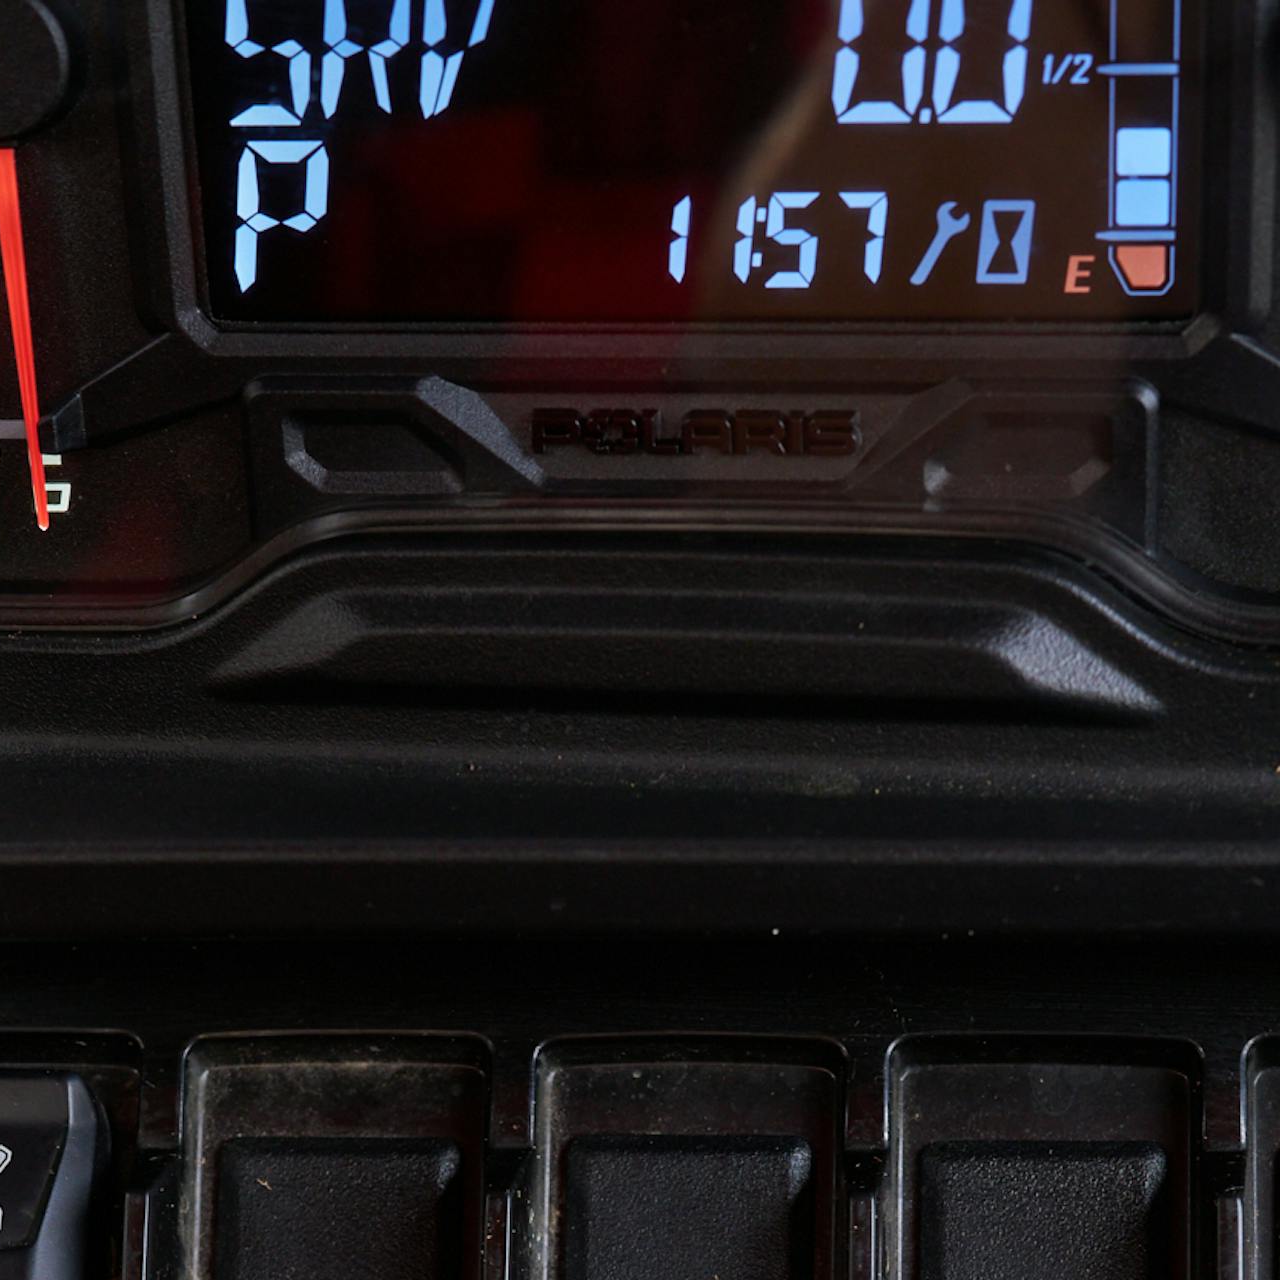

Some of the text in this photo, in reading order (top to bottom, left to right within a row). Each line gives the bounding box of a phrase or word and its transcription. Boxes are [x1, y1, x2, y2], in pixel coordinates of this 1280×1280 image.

[1040, 52, 1094, 86] 1/2
[232, 139, 330, 295] P
[668, 191, 889, 289] 11:57
[1063, 254, 1096, 294] E
[532, 408, 863, 457] POLARIS
